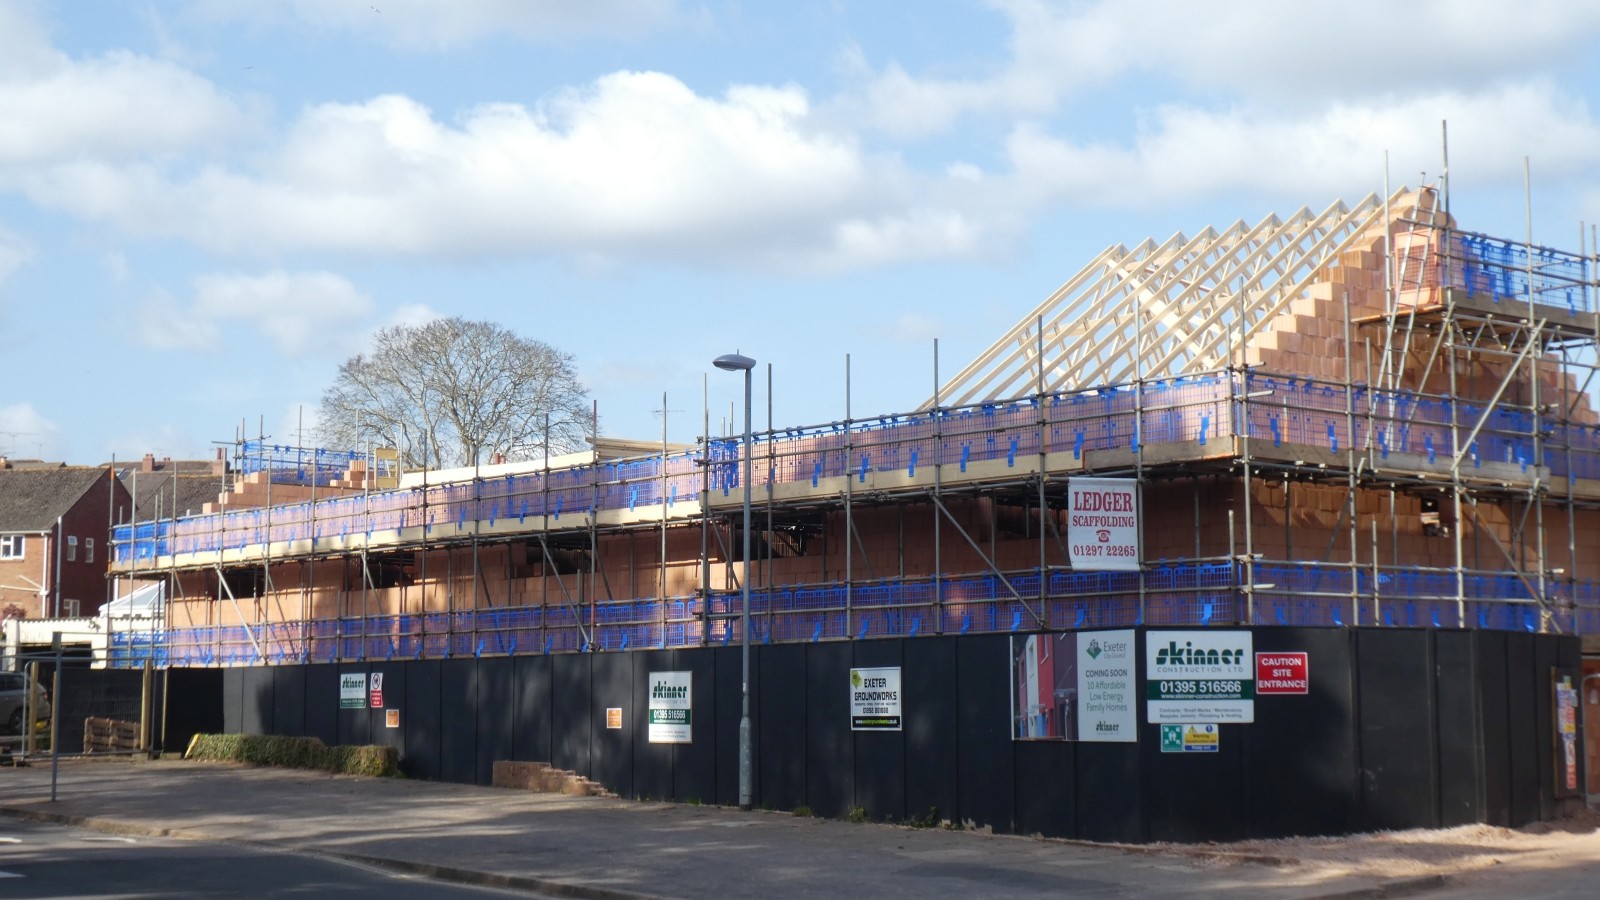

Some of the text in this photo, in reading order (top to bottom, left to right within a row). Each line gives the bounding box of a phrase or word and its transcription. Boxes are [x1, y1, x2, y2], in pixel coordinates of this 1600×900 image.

[1074, 491, 1133, 512] LEDGER
[1073, 516, 1134, 527] SCAFFOLDING
[1073, 545, 1135, 556] 01297 22265
[1104, 641, 1126, 652] Exeter
[1156, 641, 1244, 665] skinner
[1261, 657, 1302, 666] CAUTION
[1272, 669, 1292, 677] SITE
[864, 678, 886, 688] EXETER
[1087, 681, 1126, 689] 10 Affordable
[1160, 681, 1241, 693] 01395 516566
[1258, 680, 1306, 688] ENTRANCE
[653, 681, 687, 698] skinner
[855, 692, 897, 700] GROUNDWORKS
[1090, 692, 1123, 702] Low Energy
[1087, 702, 1127, 713] Family Homes
[1096, 721, 1119, 731] skinner
